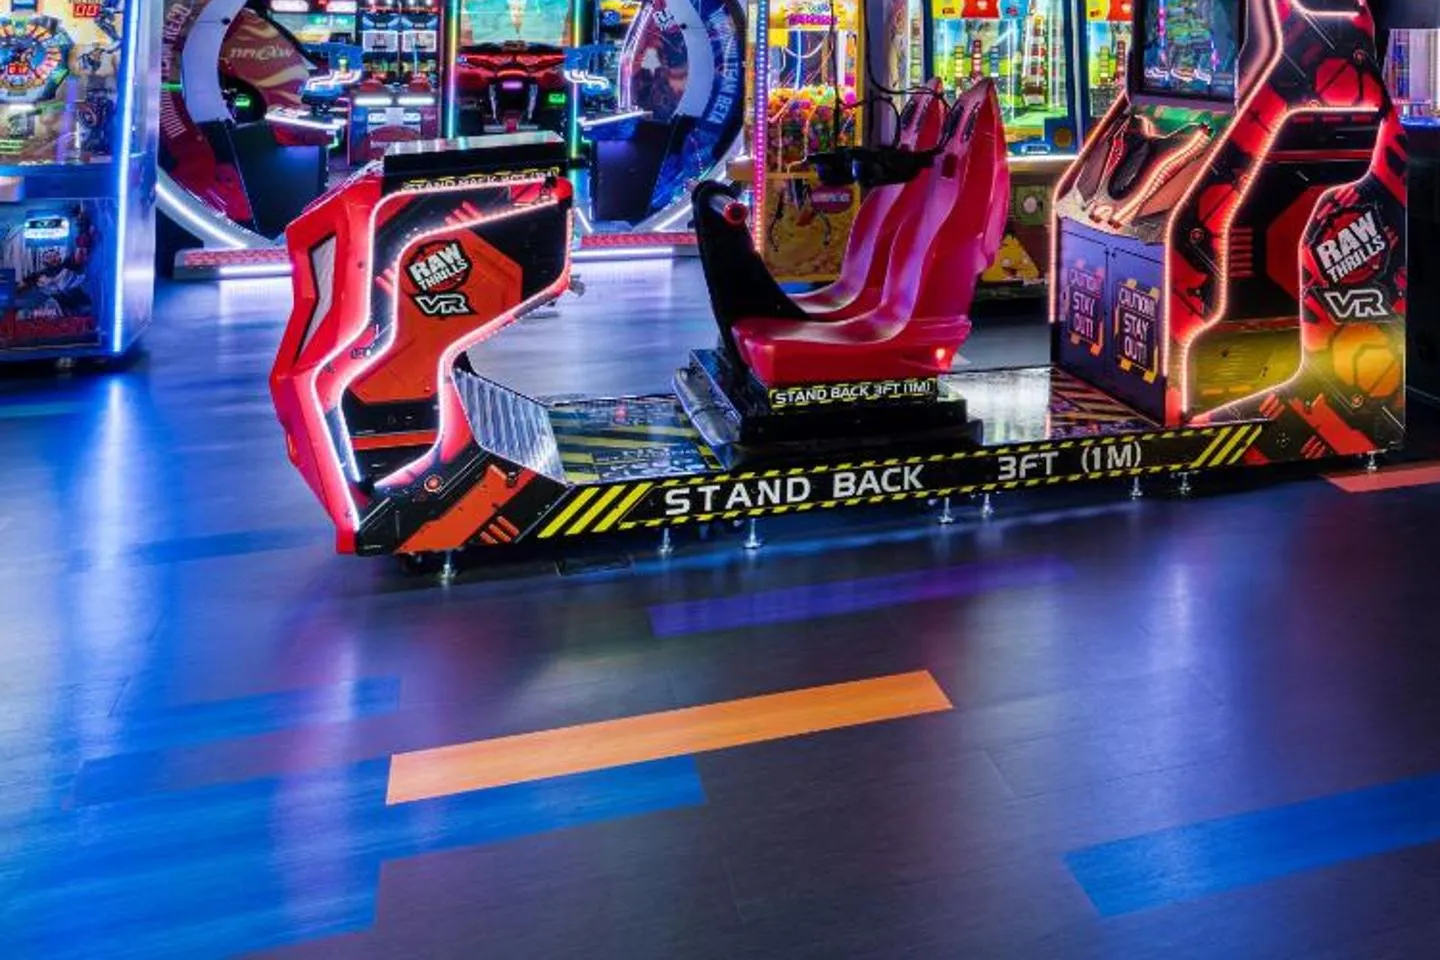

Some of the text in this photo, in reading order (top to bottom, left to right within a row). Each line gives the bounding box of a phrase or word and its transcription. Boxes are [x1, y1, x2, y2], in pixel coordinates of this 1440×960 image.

[1316, 210, 1378, 267] RAW
[407, 242, 464, 280] RAW
[417, 258, 468, 291] THRILLS
[1326, 235, 1386, 283] THRILLS
[413, 293, 471, 316] VR
[1323, 289, 1390, 319] VR
[1124, 312, 1150, 341] STAY
[775, 388, 828, 406] STAND
[831, 384, 870, 400] BACK
[664, 477, 812, 516] STAND
[832, 464, 925, 499] BACK
[997, 451, 1059, 481] 3FT
